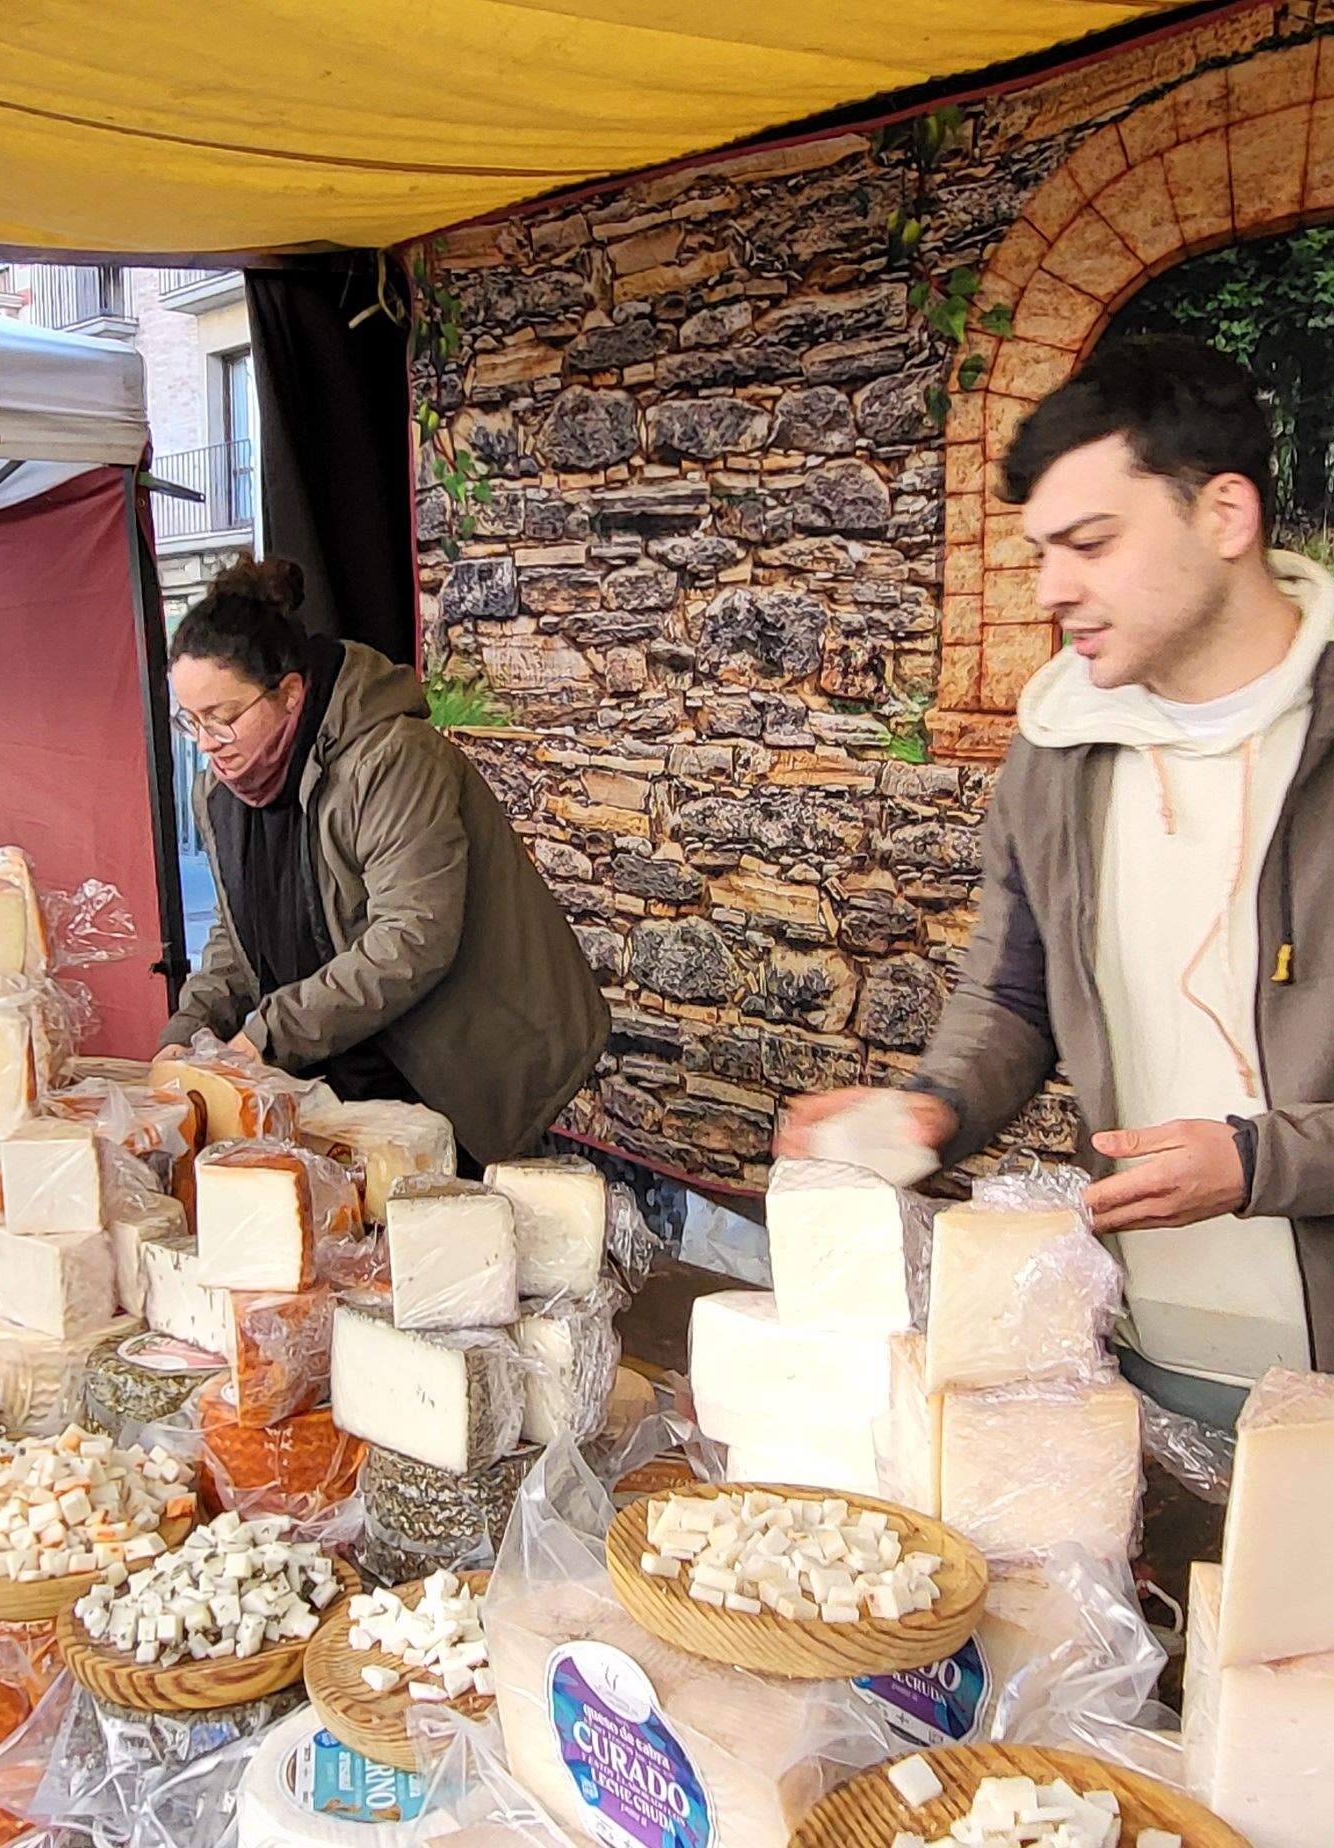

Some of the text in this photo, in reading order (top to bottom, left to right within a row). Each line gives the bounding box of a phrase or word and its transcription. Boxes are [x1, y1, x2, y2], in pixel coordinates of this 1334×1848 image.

[906, 1673, 947, 1706] CRUDA
[573, 1721, 690, 1818] CURADO
[583, 1703, 618, 1737] queso
[619, 1725, 635, 1746] de
[635, 1737, 670, 1770] cabra
[591, 1766, 633, 1805] LECHE
[633, 1795, 676, 1836] CRUDA
